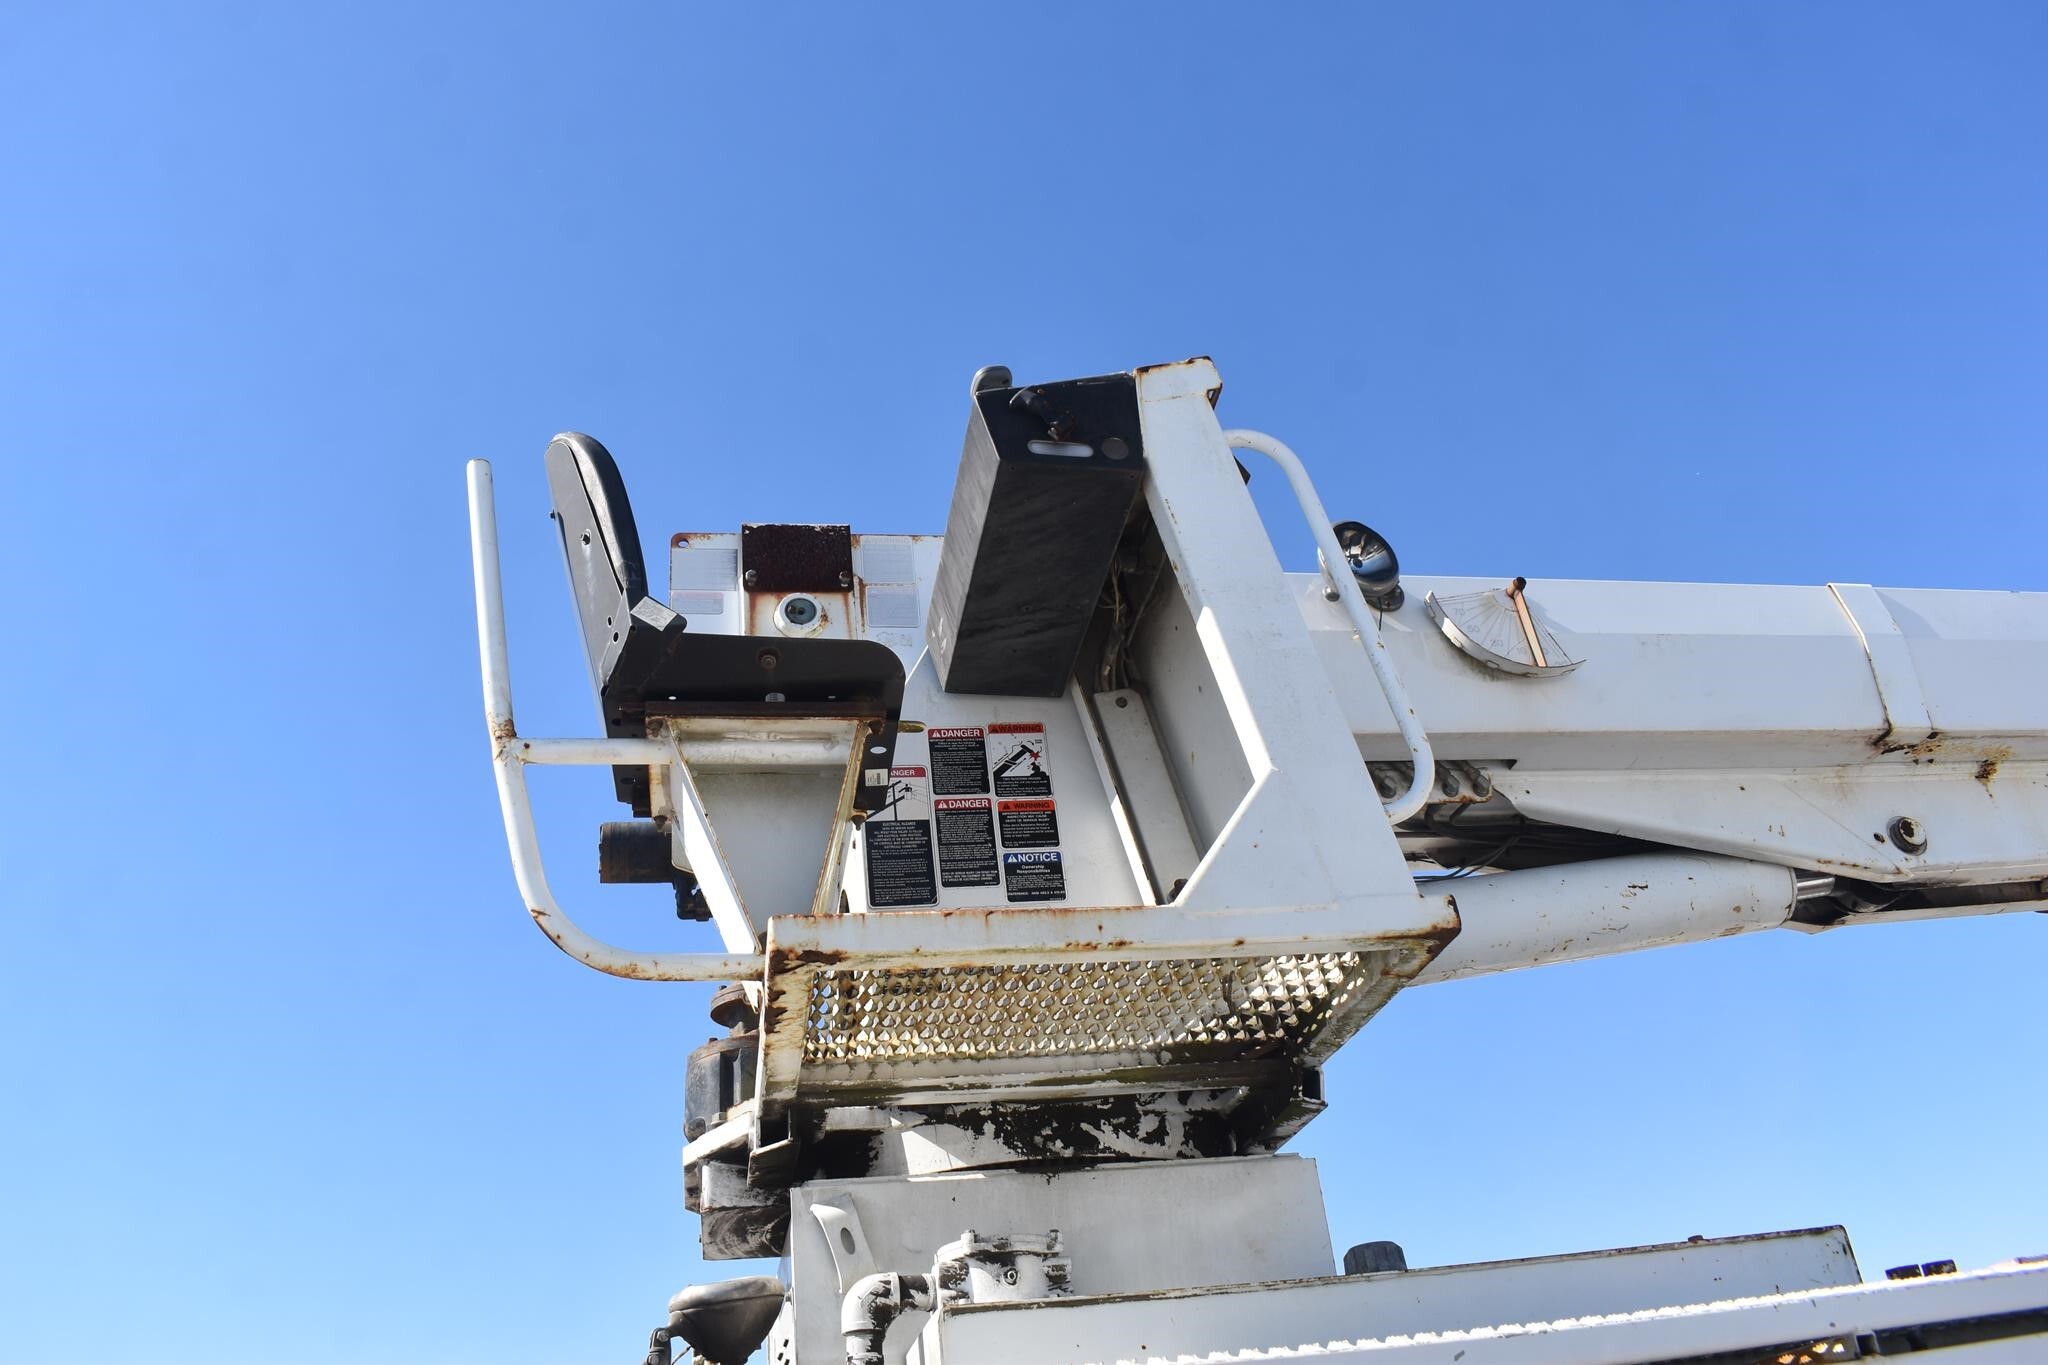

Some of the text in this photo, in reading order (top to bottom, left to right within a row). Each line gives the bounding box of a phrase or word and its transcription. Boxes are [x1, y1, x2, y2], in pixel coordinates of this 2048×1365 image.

[998, 724, 1042, 733] WARNING
[941, 729, 980, 738] DANGER
[948, 799, 989, 808] DANGER
[1013, 802, 1050, 810] WARNING
[1017, 852, 1058, 863] NOTICE
